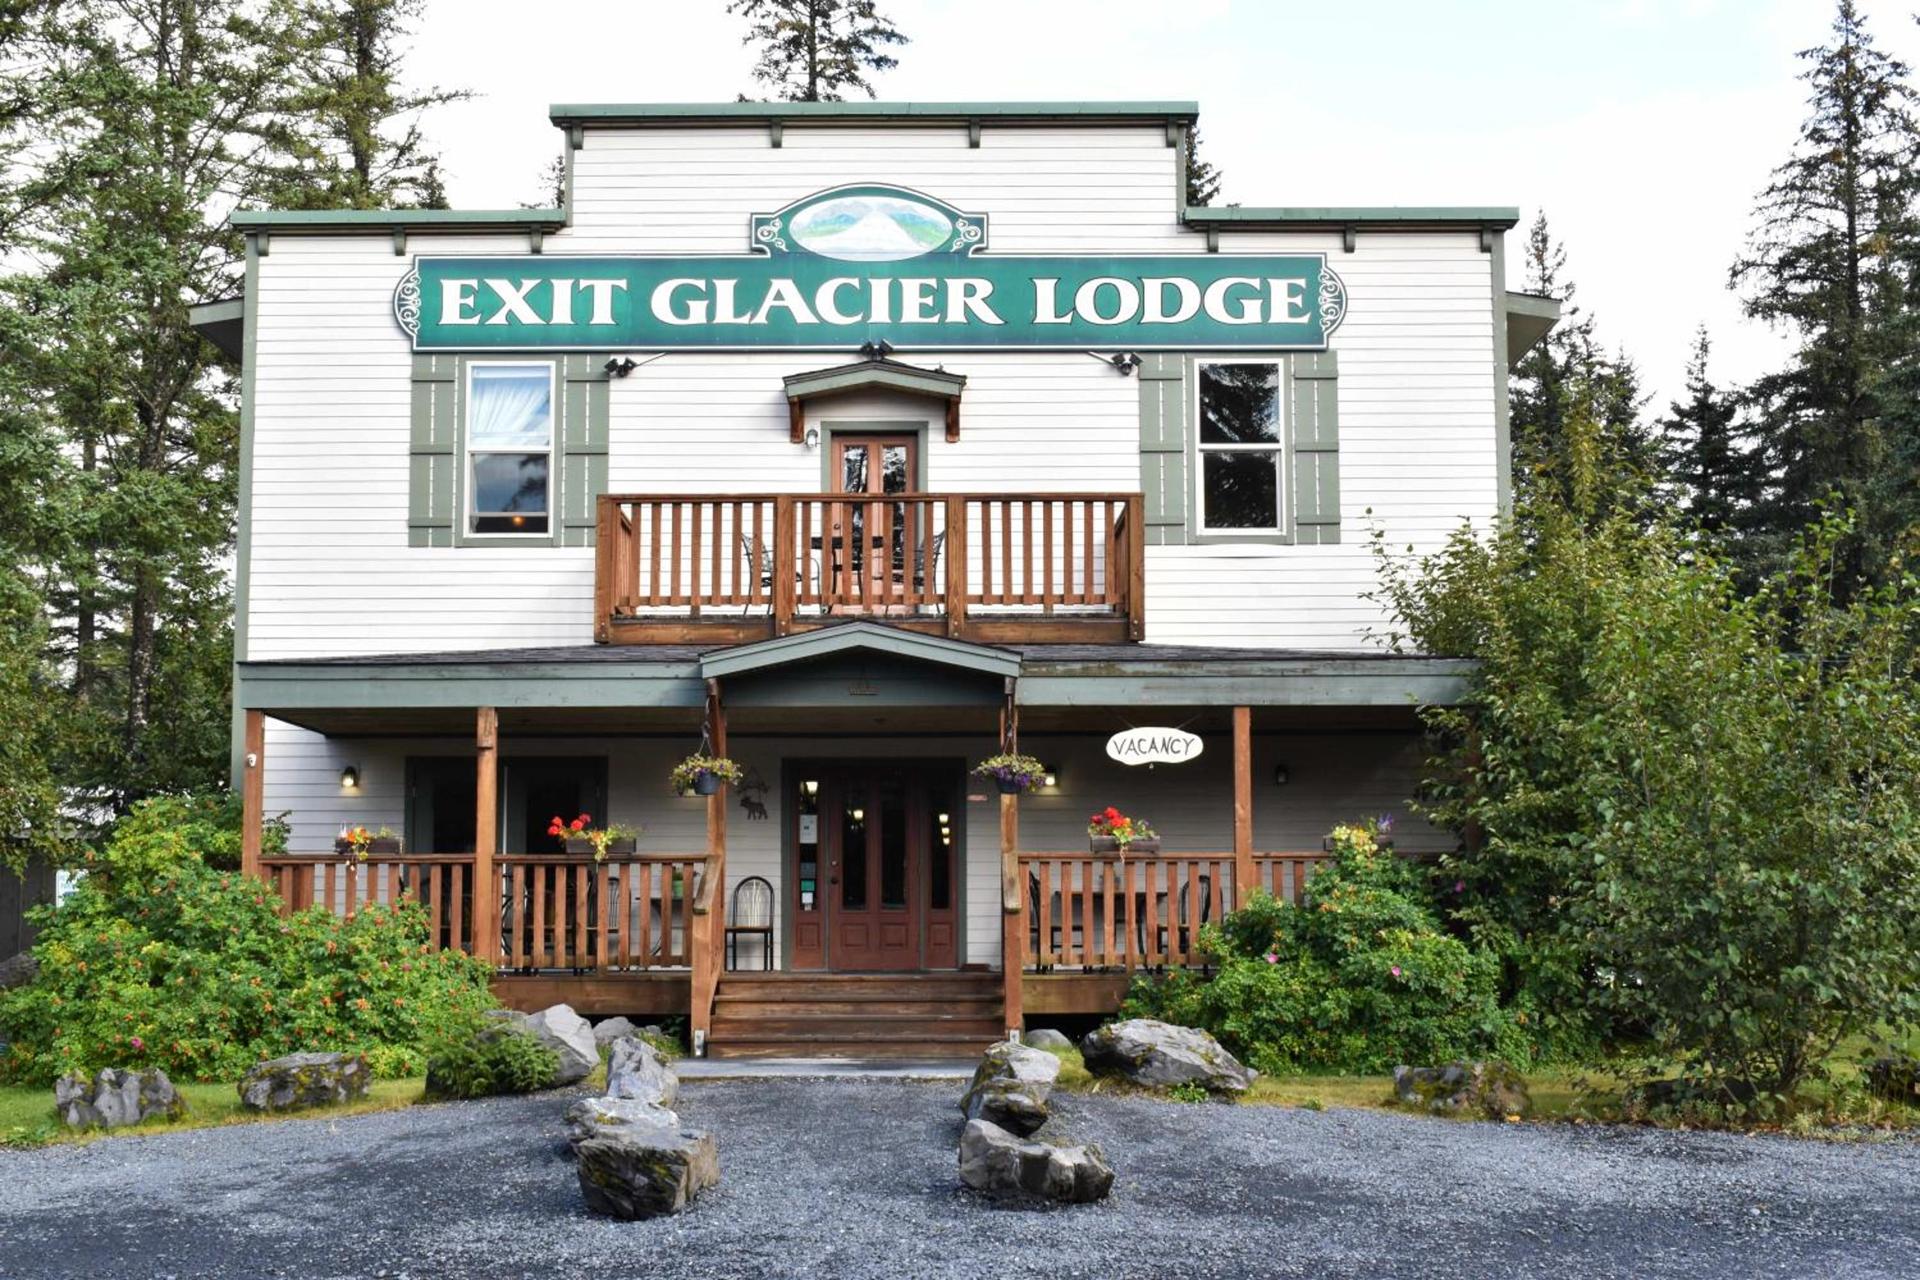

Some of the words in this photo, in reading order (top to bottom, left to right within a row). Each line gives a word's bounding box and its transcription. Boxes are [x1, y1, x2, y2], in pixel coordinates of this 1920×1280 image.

[437, 277, 628, 325] EXIT
[650, 276, 1005, 325] GLACIER
[1033, 276, 1312, 325] LODGE
[1113, 736, 1195, 756] VACANCY
